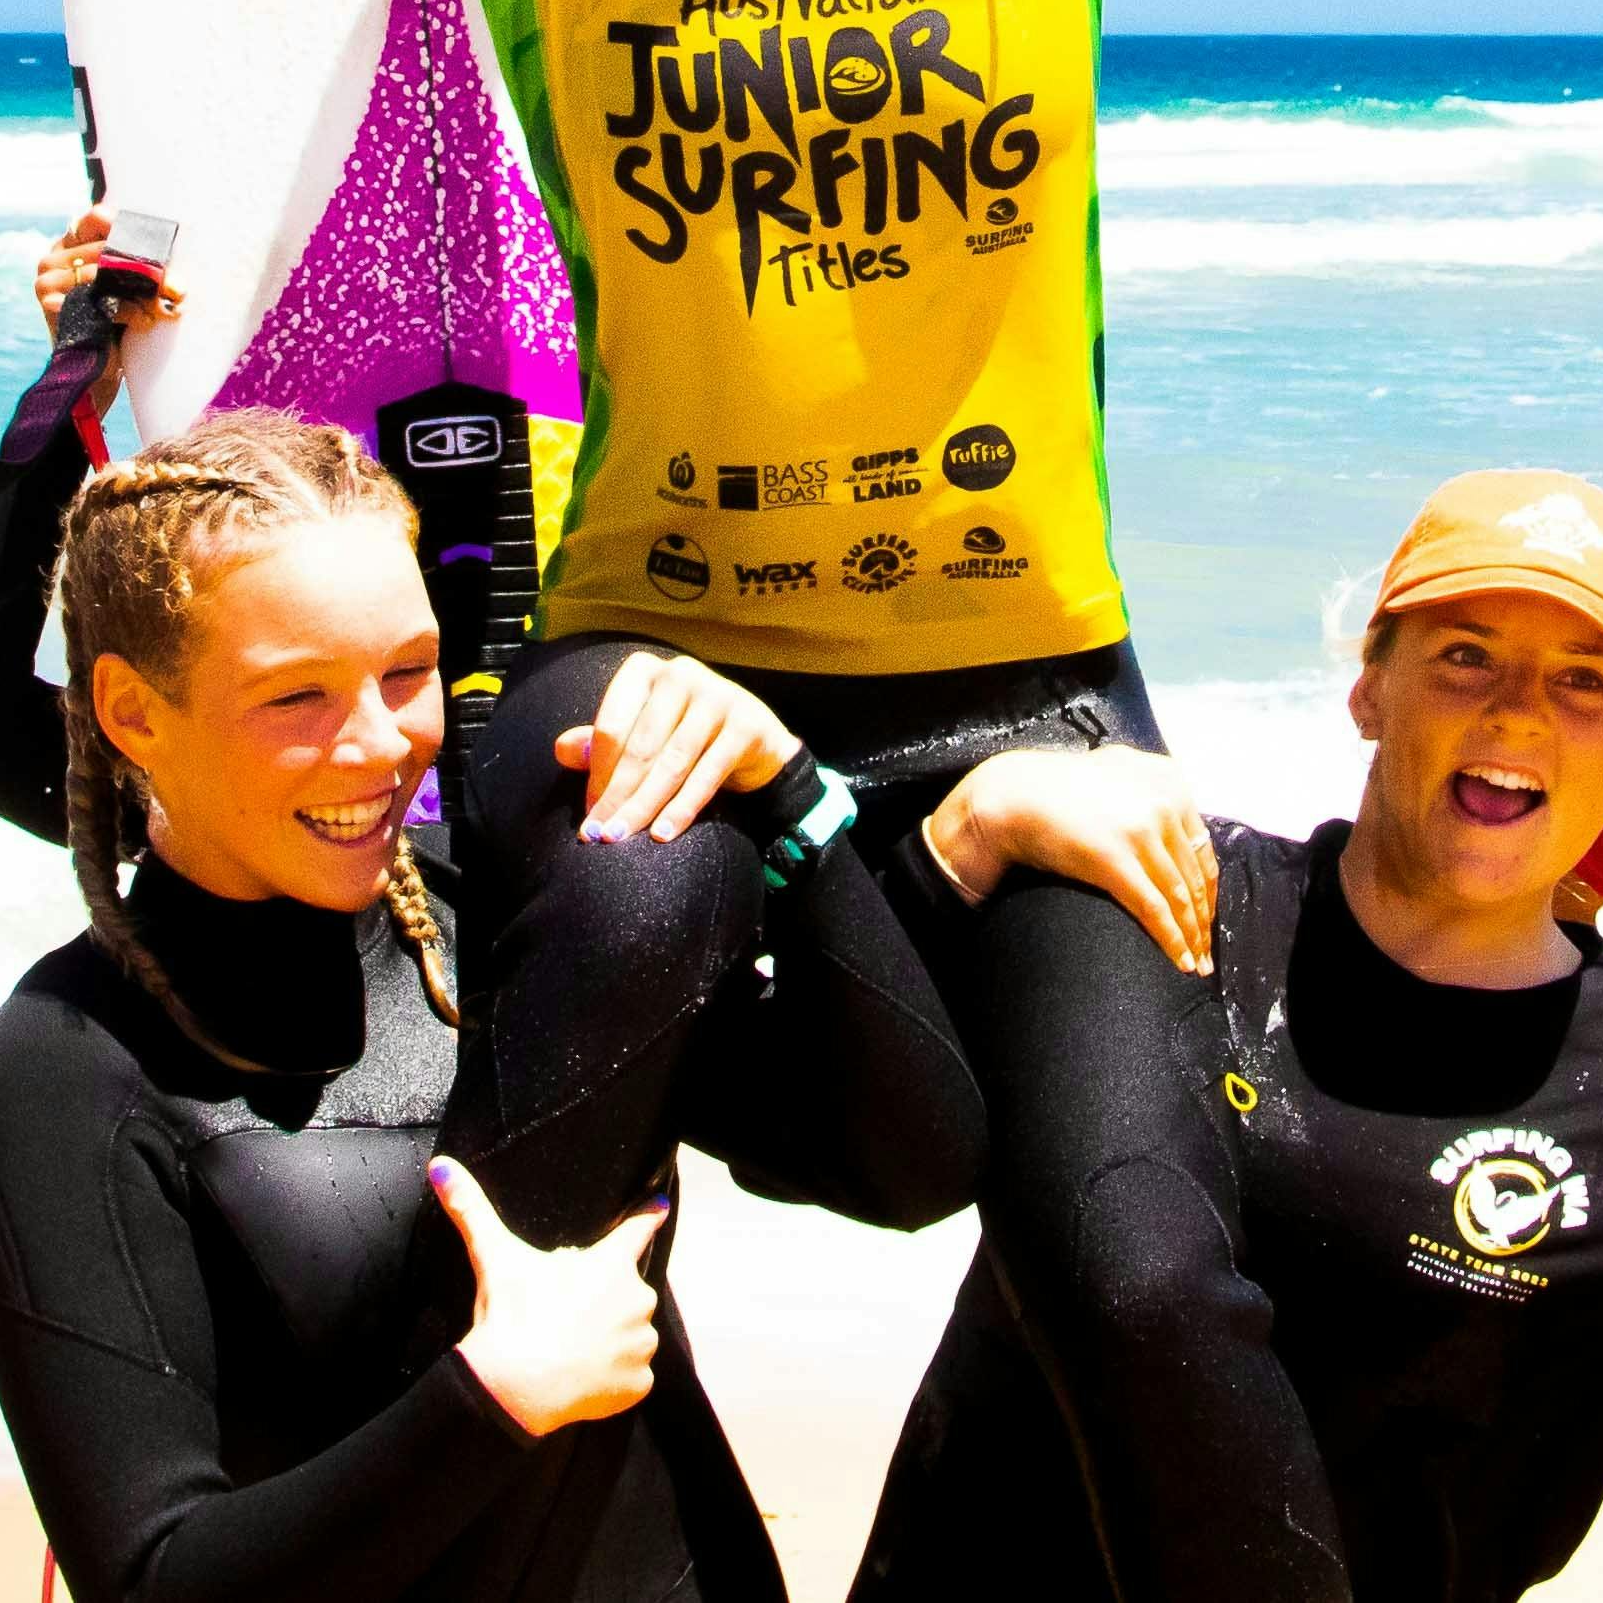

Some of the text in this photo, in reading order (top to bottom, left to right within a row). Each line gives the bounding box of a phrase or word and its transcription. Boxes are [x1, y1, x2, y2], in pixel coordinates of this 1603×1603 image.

[605, 9, 987, 167] JUNIOR
[613, 93, 1040, 319] SURFING
[965, 222, 1034, 247] SURFING
[768, 241, 910, 306] Titles
[763, 460, 829, 487] BASS
[851, 447, 920, 473] GIPPS
[764, 484, 828, 505] COAST
[853, 478, 922, 503] LAND
[941, 558, 1029, 575] SURFING
[1430, 1128, 1573, 1186] SURFING
[1409, 1233, 1459, 1261] STATE
[1465, 1255, 1505, 1276] TEAM
